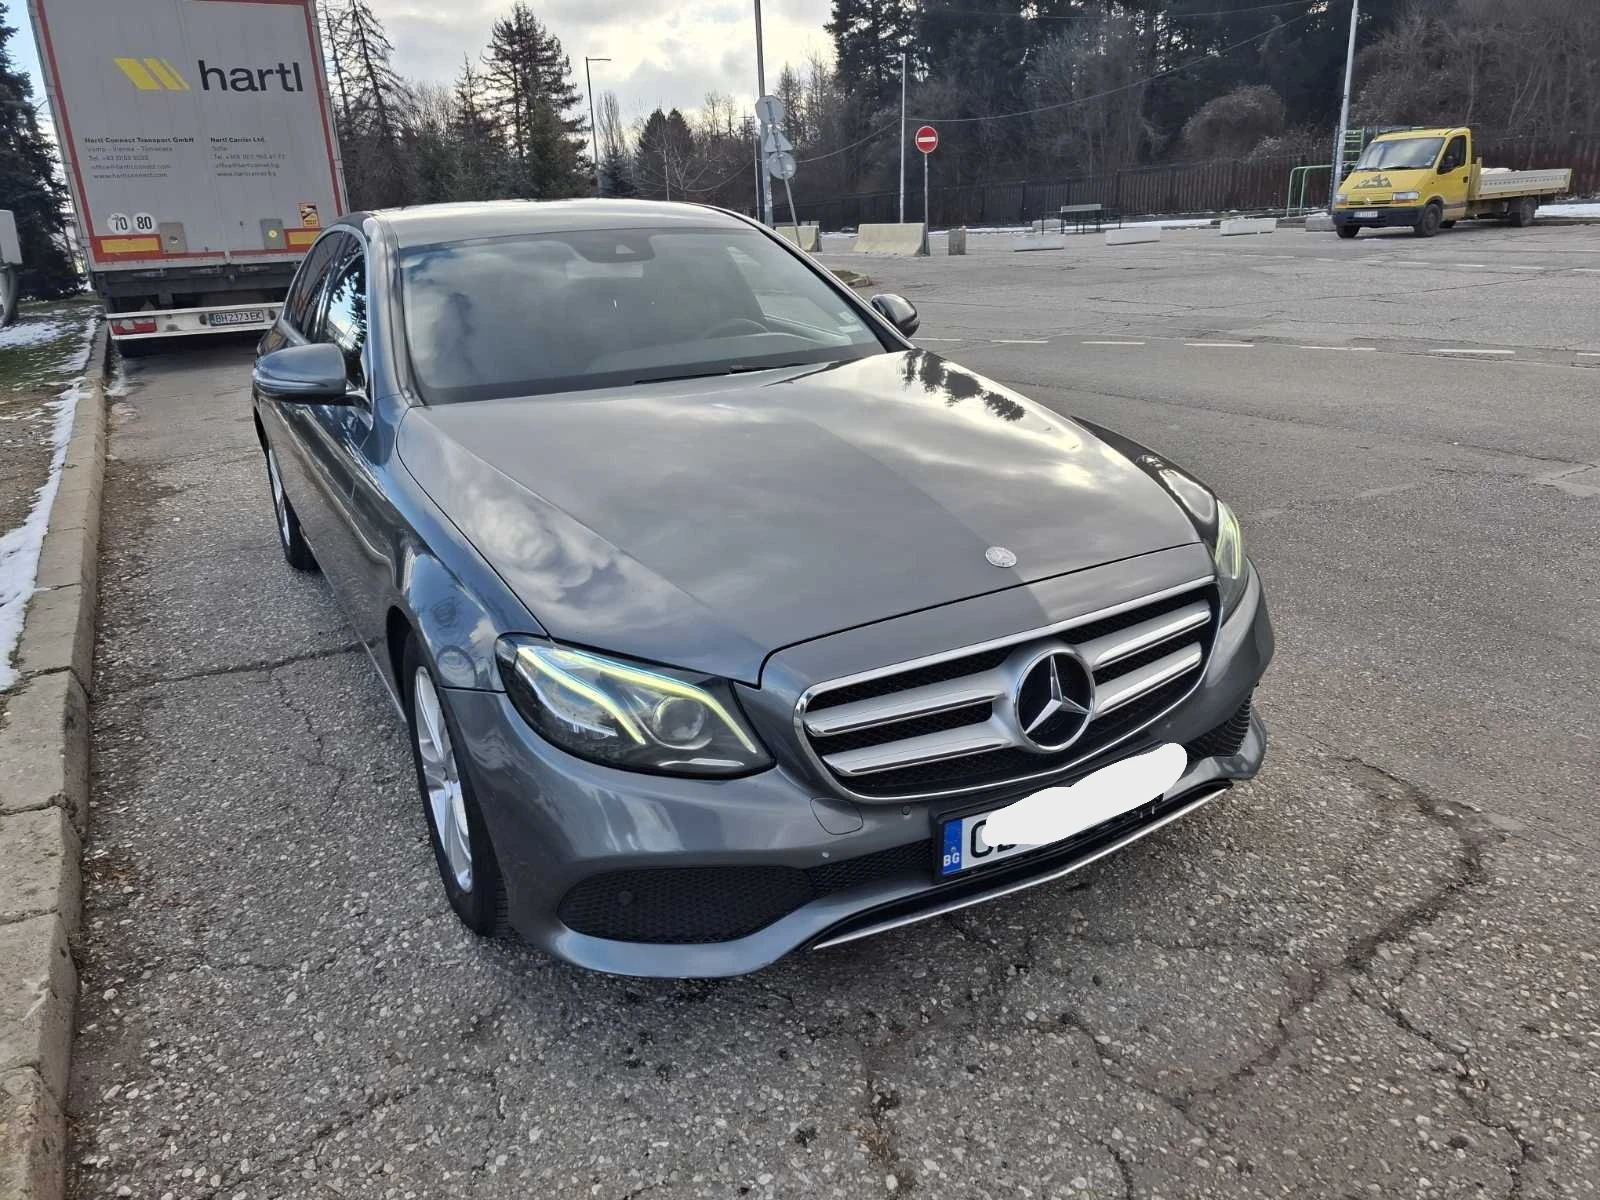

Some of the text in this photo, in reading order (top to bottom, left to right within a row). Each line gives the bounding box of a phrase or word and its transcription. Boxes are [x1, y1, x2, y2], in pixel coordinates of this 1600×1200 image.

[198, 59, 303, 92] hartl
[112, 215, 128, 231] 70
[136, 216, 152, 230] 80
[943, 852, 960, 867] BG
